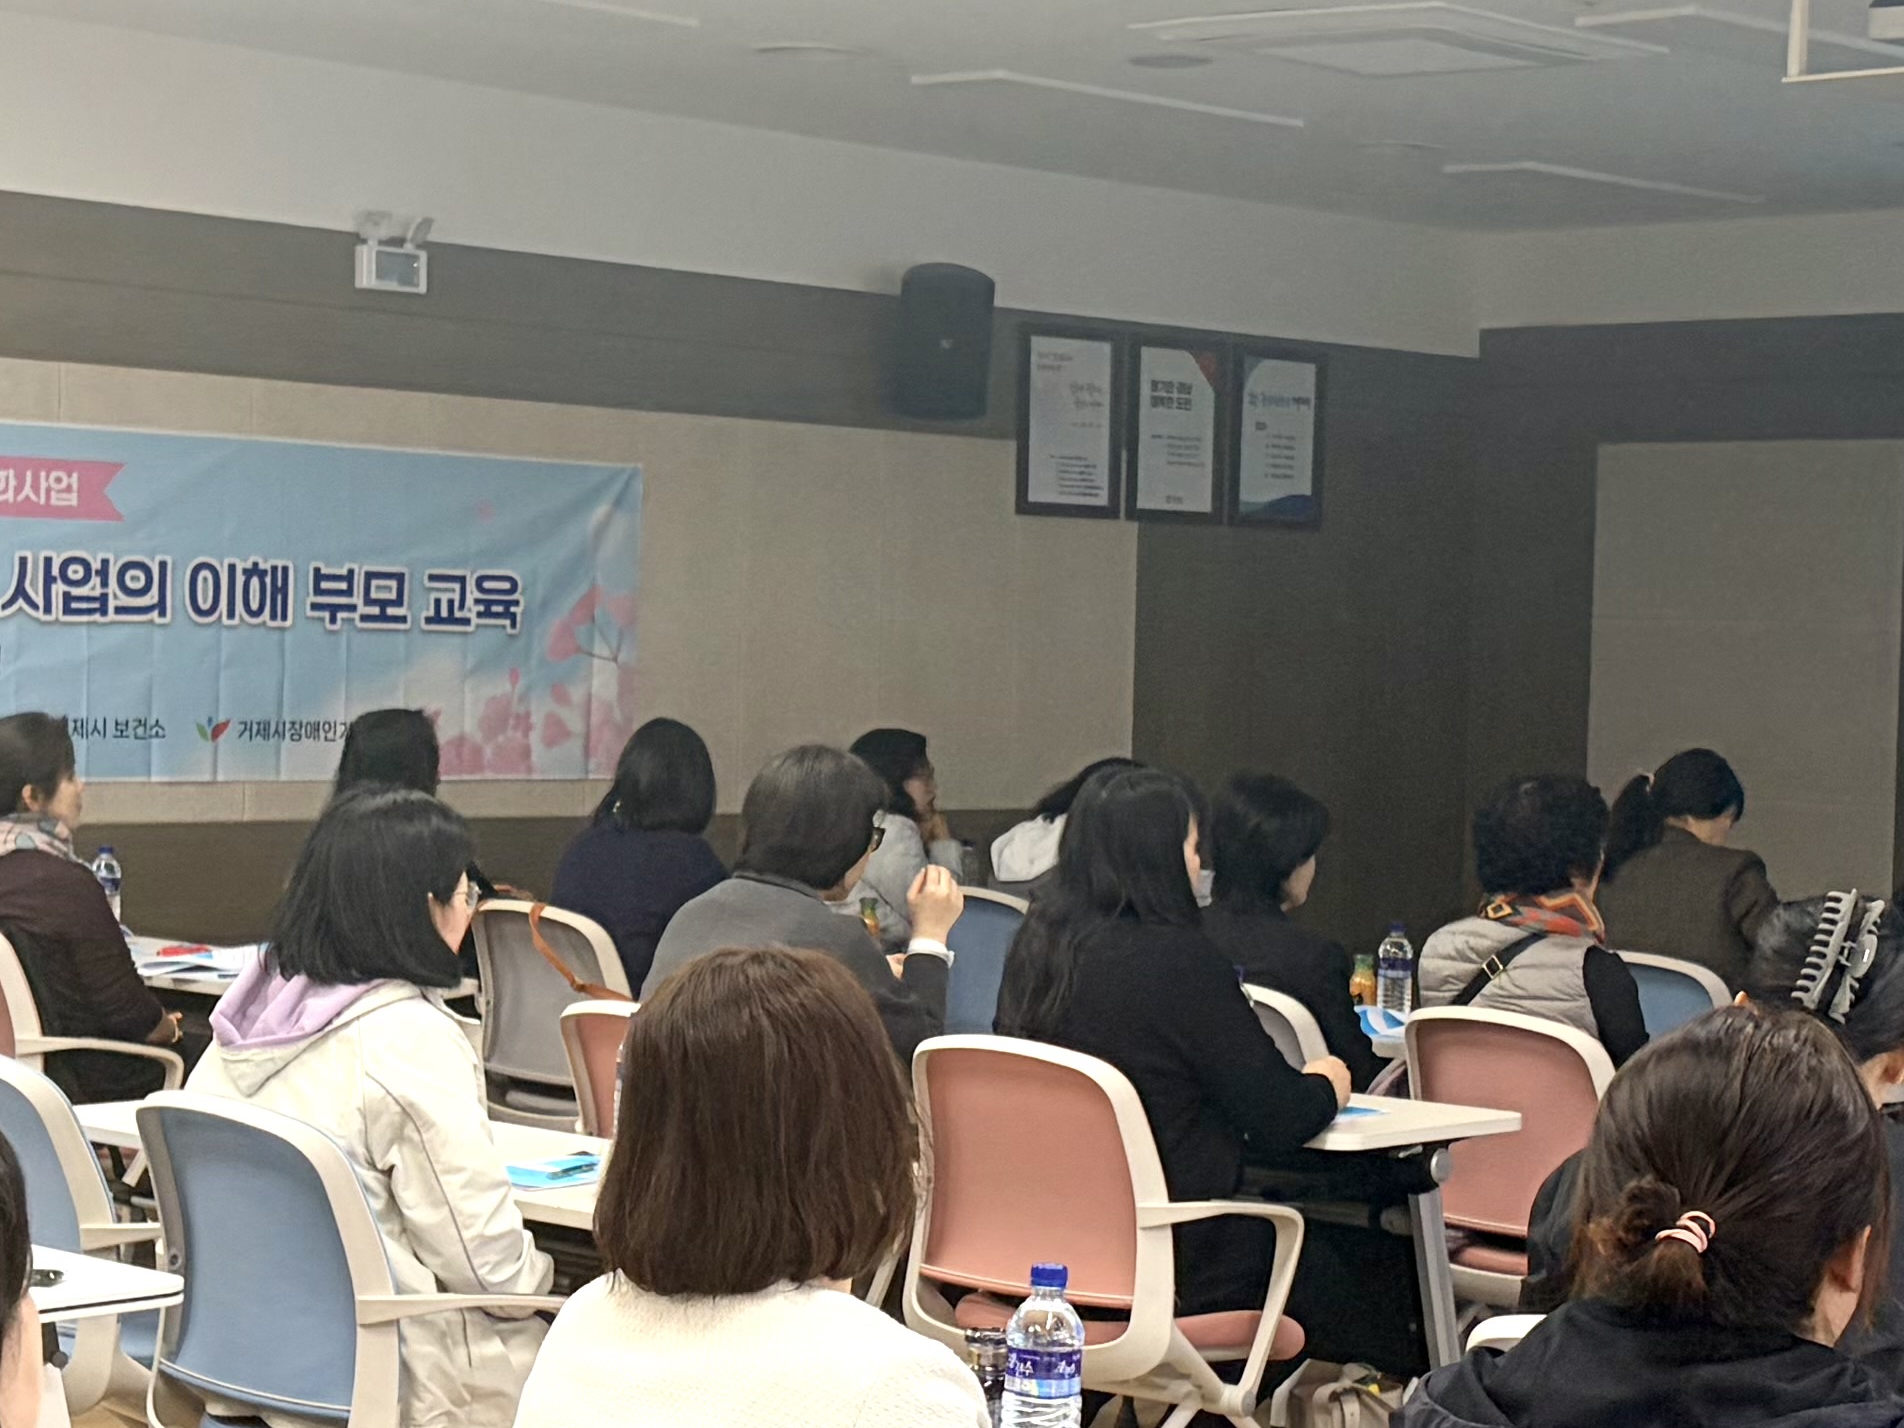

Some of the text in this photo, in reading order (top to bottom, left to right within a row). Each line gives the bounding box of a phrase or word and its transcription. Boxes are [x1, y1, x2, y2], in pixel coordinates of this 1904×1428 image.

[186, 558, 292, 626] 이해
[307, 563, 411, 630] 부모
[421, 569, 524, 633] 교육
[112, 717, 166, 741] 보건소
